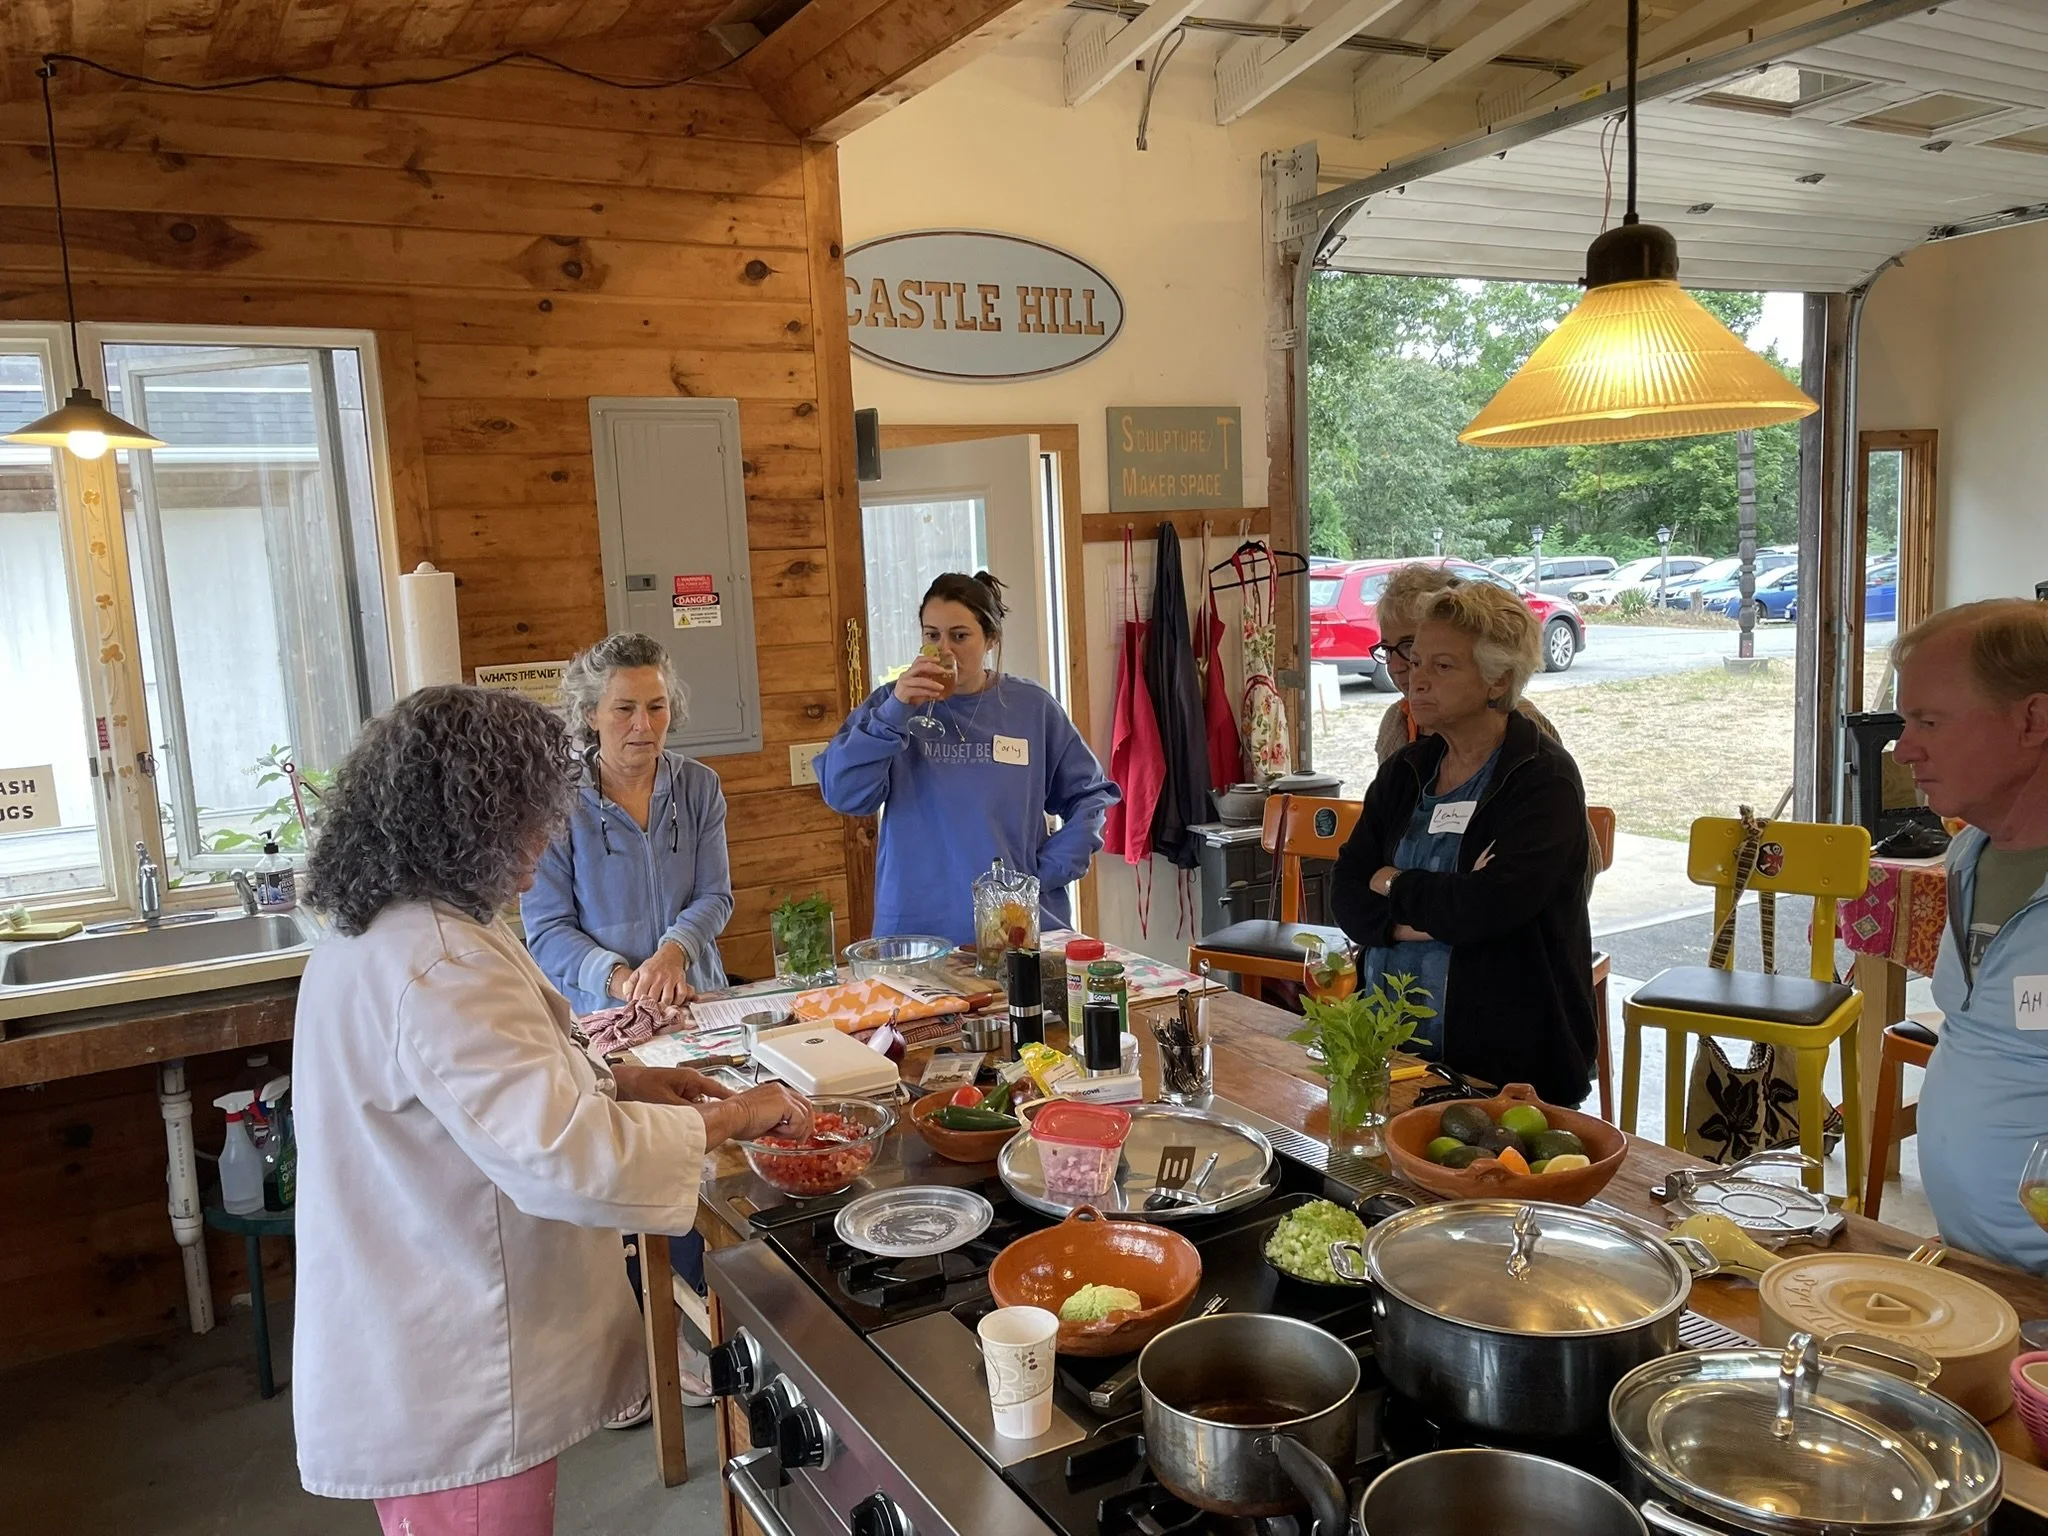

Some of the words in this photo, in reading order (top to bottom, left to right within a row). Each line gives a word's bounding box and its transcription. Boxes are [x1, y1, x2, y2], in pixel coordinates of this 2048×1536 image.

[845, 276, 1002, 332] CASTLE
[1016, 285, 1105, 336] HILL
[1122, 467, 1176, 497] MAKER
[1180, 473, 1222, 497] SPACE
[679, 595, 713, 604] DANGER
[479, 671, 518, 683] WHATS
[519, 670, 536, 681] THE
[537, 668, 561, 679] WIFI
[924, 741, 972, 758] NAUSET
[976, 742, 991, 758] BE
[1082, 1088, 1100, 1096] GOYA
